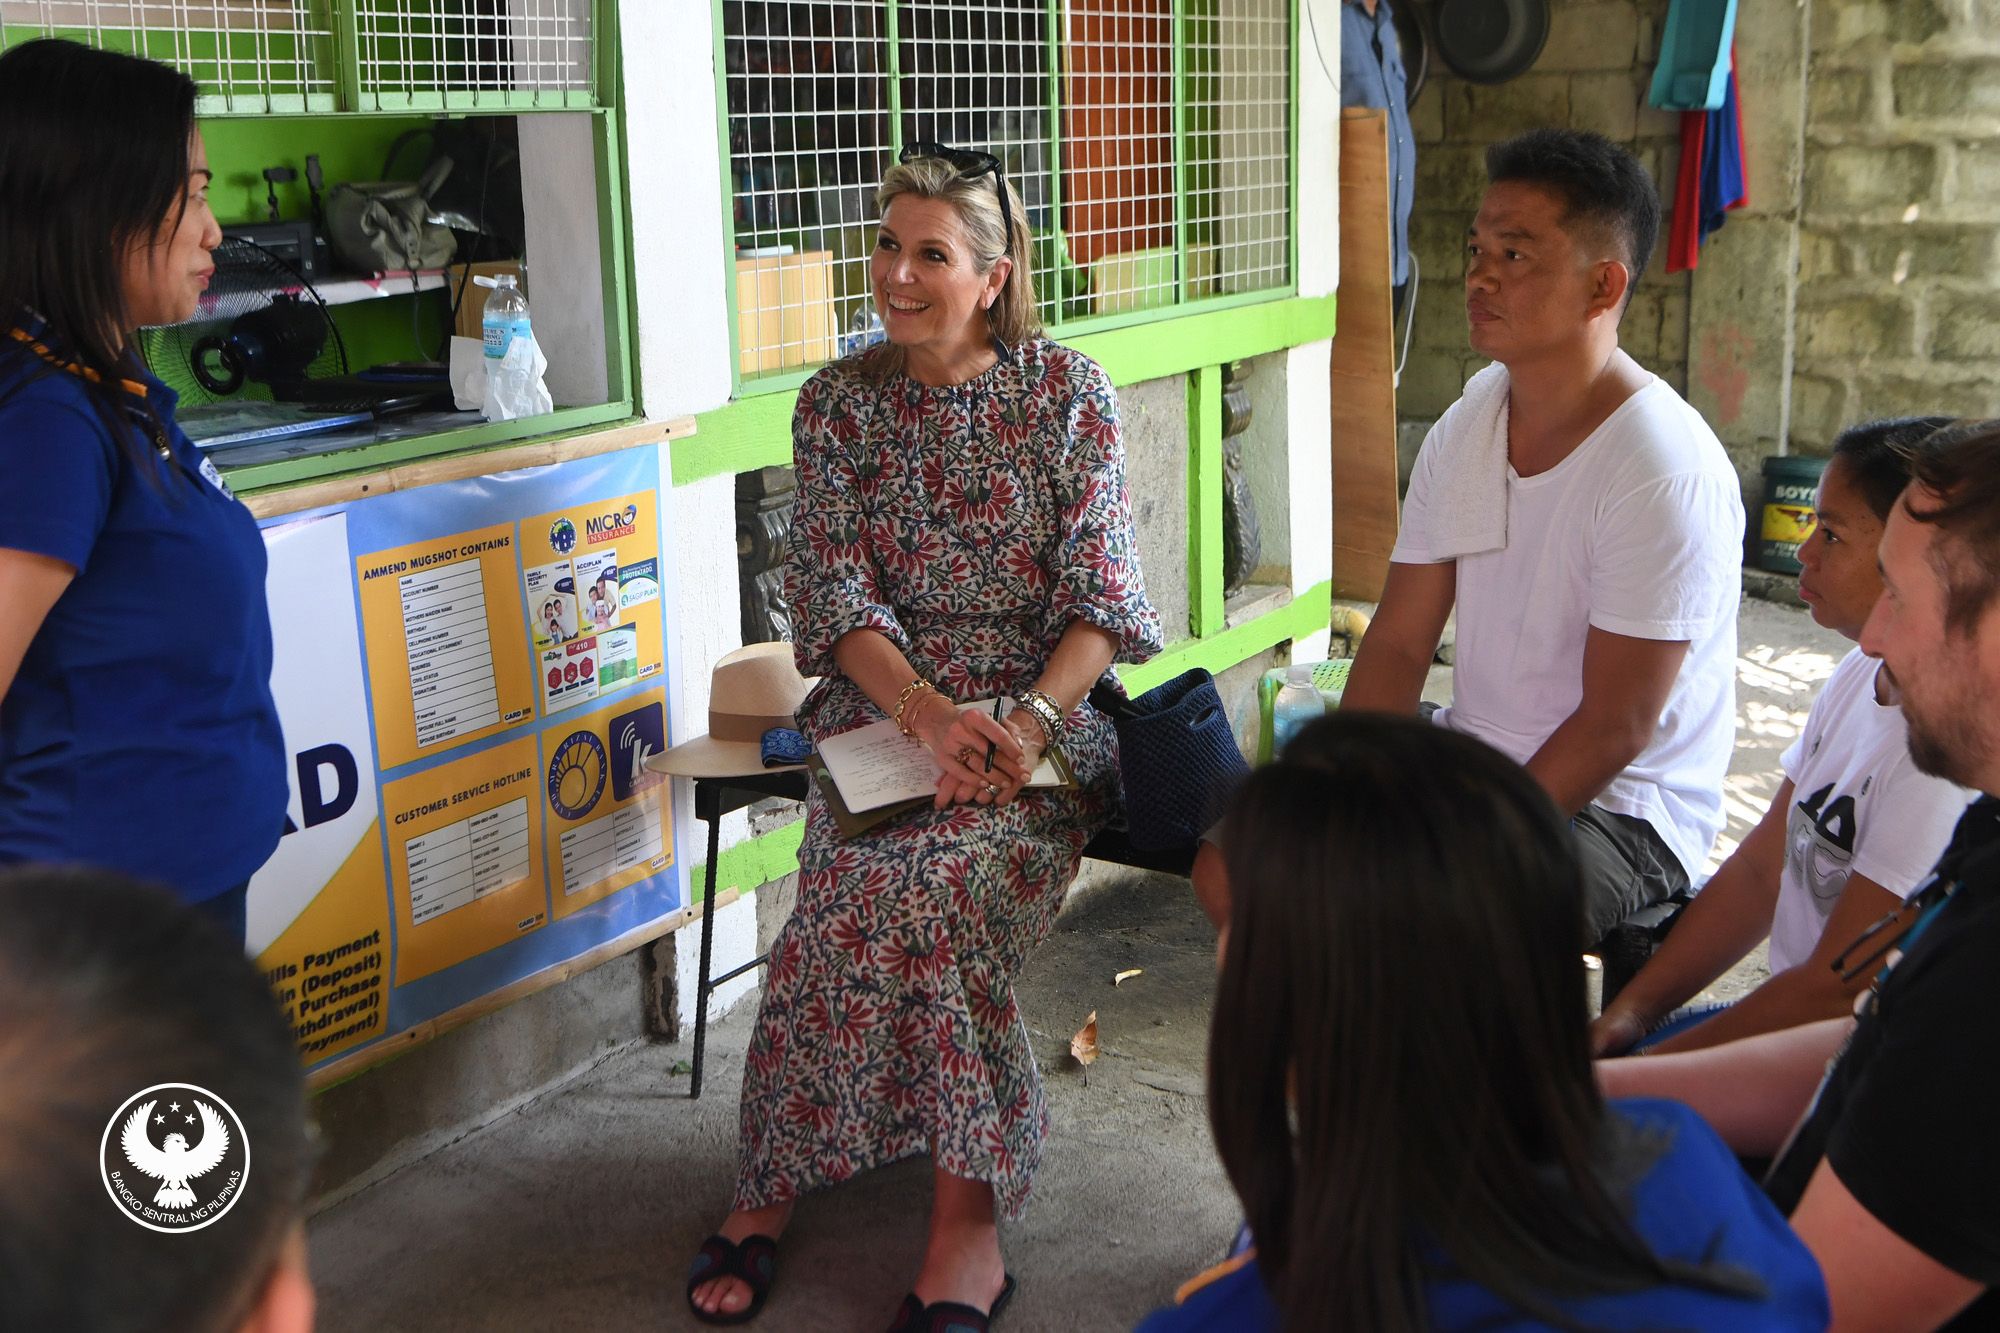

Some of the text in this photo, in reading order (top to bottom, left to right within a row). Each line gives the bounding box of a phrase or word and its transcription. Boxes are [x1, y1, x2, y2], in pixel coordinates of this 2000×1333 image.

[586, 504, 637, 535] MICRO
[588, 525, 635, 544] INSURANCE
[363, 536, 510, 581] AMMEND MUGSHOT CONTAINS
[576, 560, 602, 570] ACCIPLAN
[622, 566, 653, 580] PROTEKTADO
[401, 578, 413, 586] NAME
[402, 584, 439, 598] ACCOUNT NUMBER
[644, 588, 658, 596] PLAN
[407, 625, 427, 635] BIRTHDAY
[408, 632, 449, 647] CELLPHONE NUMBER
[410, 648, 437, 660] EDUCATIONAL
[411, 662, 431, 672] BUSINESS
[640, 665, 653, 675] CARD
[423, 672, 439, 681] STATUS
[413, 685, 437, 696] SIGNATURE
[504, 711, 521, 721] CARD
[395, 798, 449, 825] CUSTOMER
[452, 783, 490, 805] SERVICE
[493, 768, 531, 789] HOTLINE
[270, 929, 380, 984] ills Payment
[301, 951, 381, 998] (Deposit)
[300, 975, 380, 1017] Purchase
